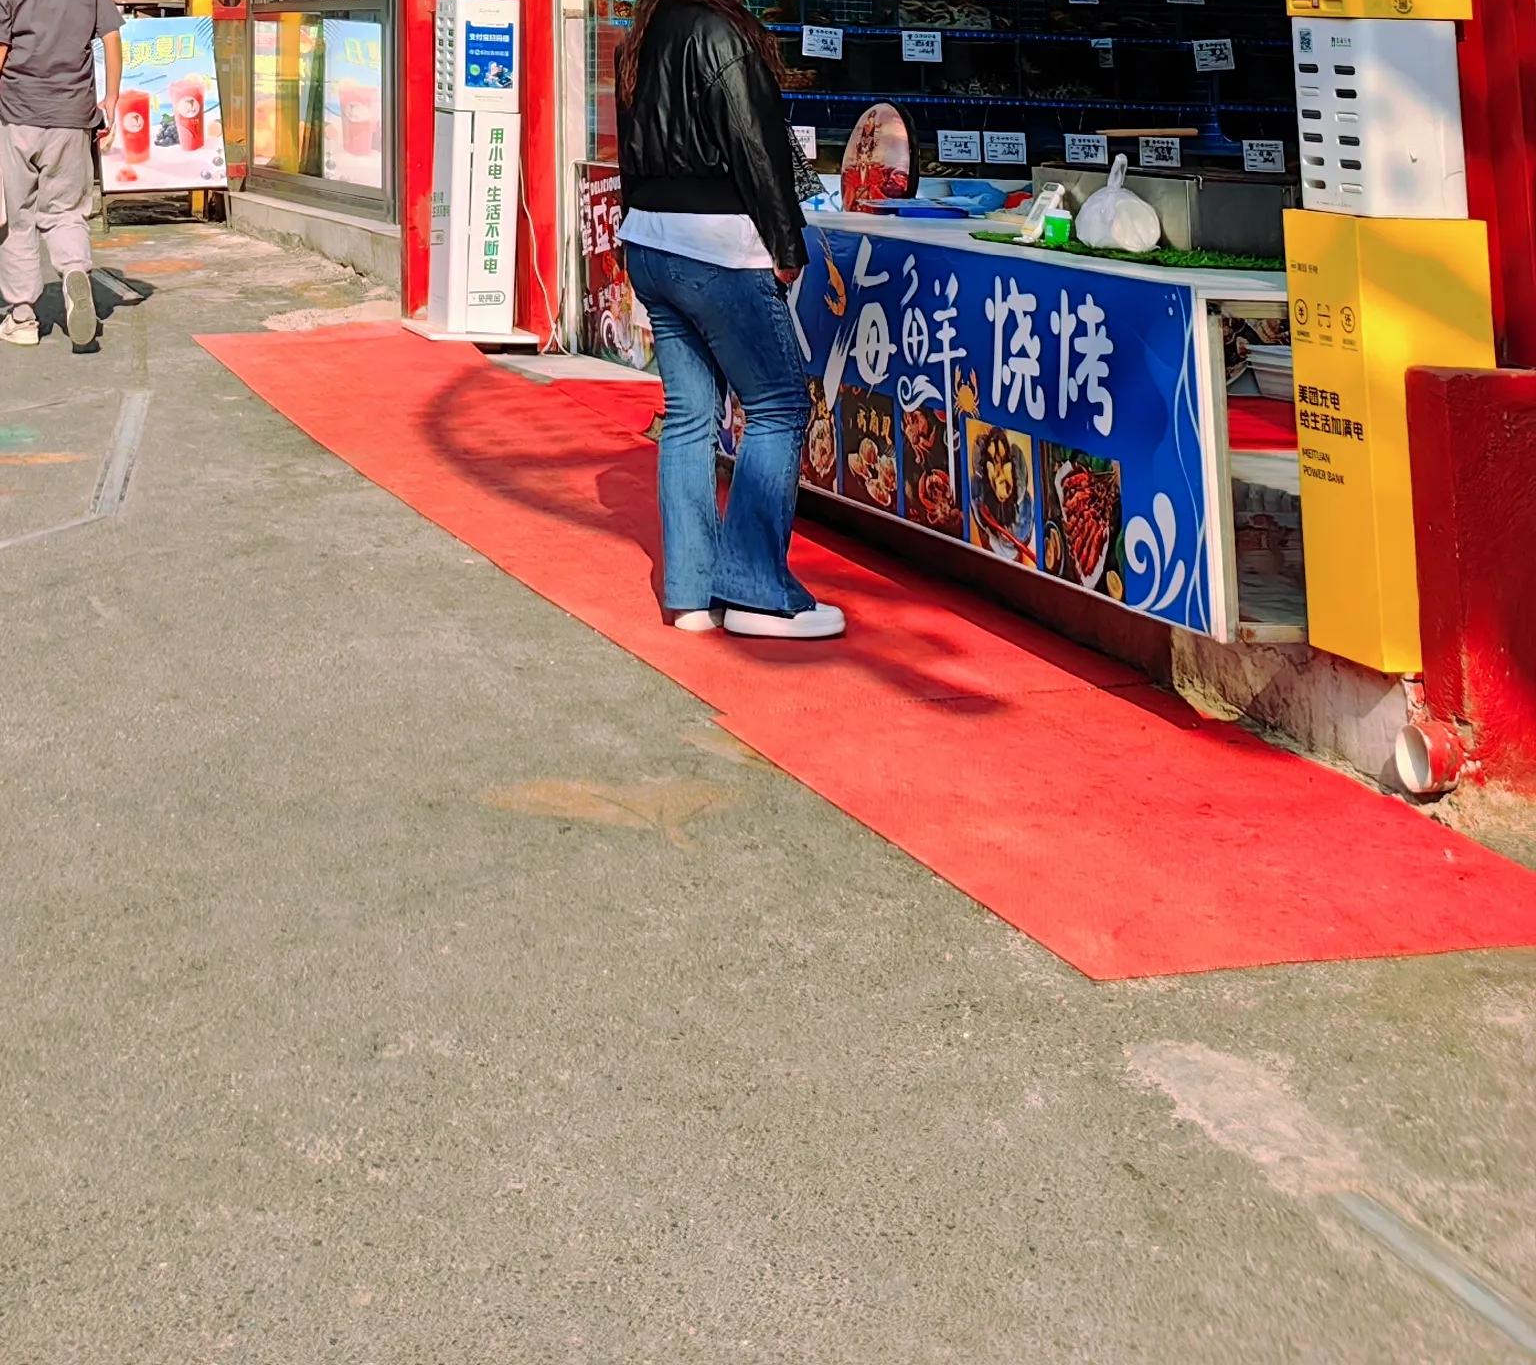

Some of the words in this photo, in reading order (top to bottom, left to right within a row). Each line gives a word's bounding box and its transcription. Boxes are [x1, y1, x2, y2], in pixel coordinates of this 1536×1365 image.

[487, 127, 505, 181] 用小电
[482, 185, 502, 275] 生活不断电
[823, 235, 1115, 505] 海鲜烧烤
[1298, 384, 1341, 411] 美团充电
[1299, 411, 1365, 442] 给生活加满电
